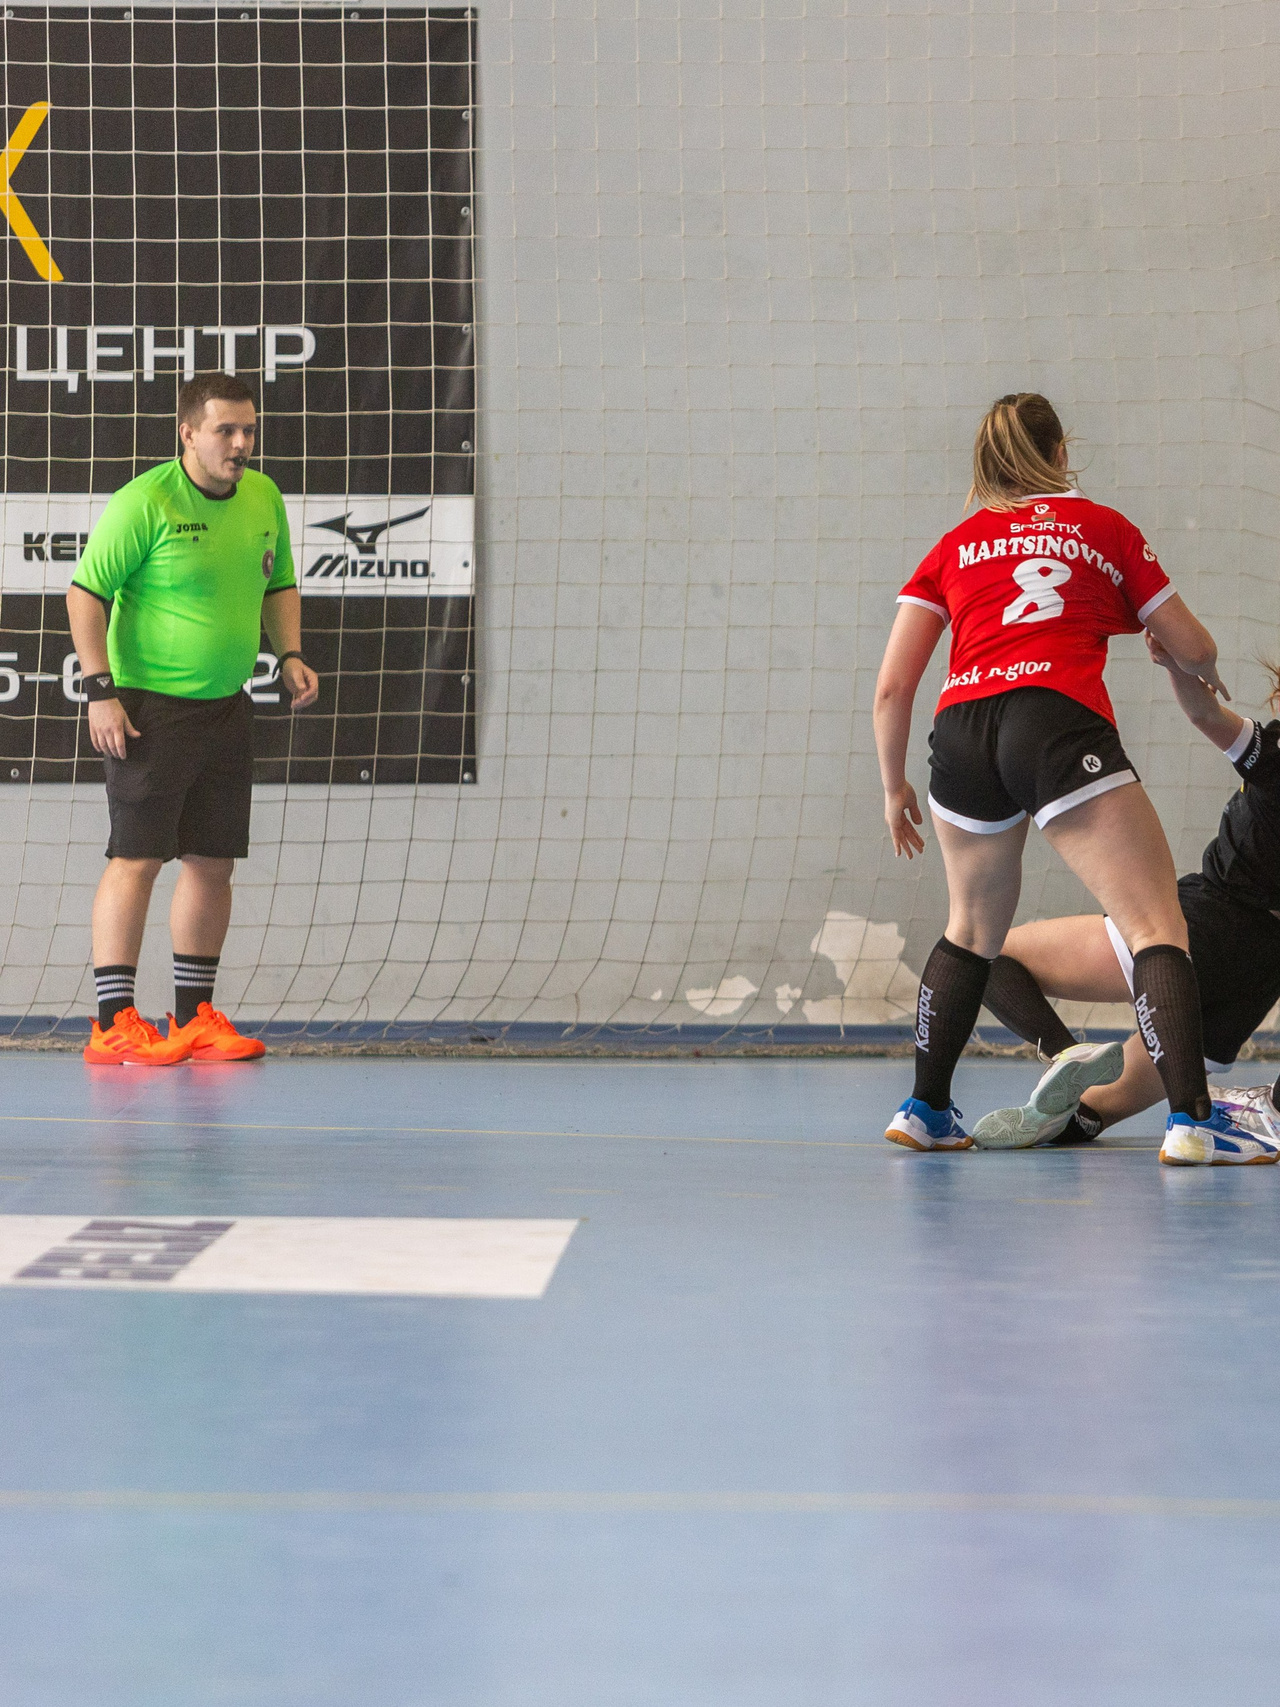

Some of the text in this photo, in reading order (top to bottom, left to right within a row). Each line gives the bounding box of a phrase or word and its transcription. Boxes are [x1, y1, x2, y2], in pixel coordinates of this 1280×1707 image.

[15, 325, 316, 394] ЦЕНТР
[1001, 557, 1073, 626] 8
[915, 983, 937, 1053] Kempa
[1135, 993, 1165, 1064] Kempa
